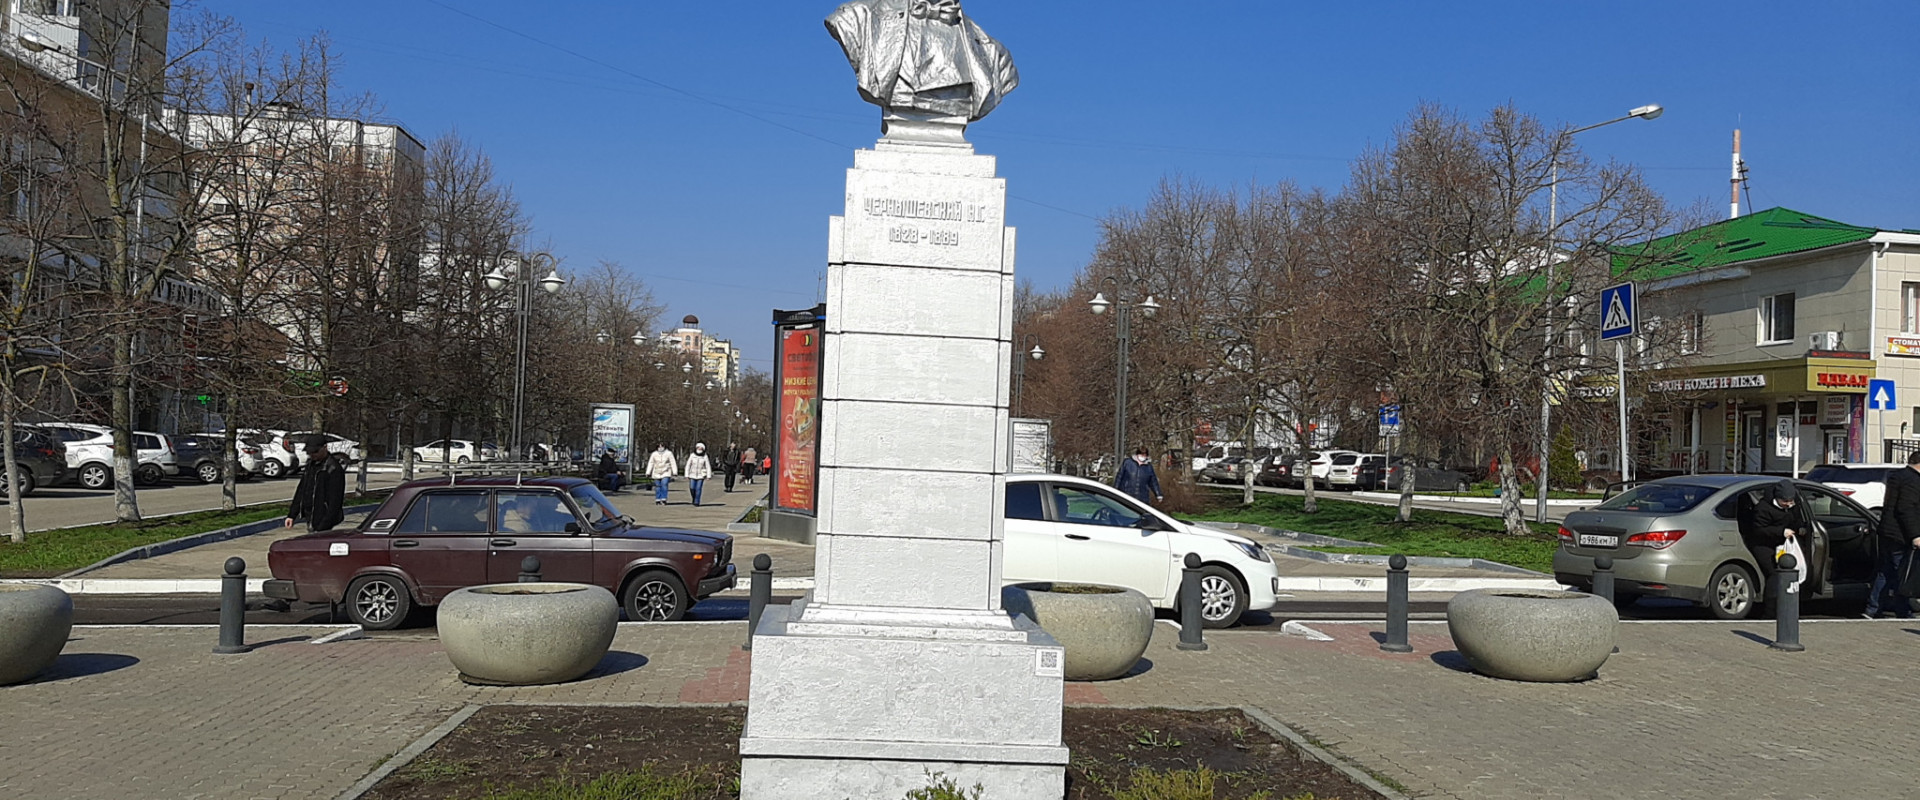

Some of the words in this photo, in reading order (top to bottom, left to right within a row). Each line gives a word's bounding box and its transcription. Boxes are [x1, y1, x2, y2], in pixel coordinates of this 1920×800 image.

[863, 197, 962, 222] ЧЕРНЫШЕВСКИЙ
[1684, 378, 1718, 391] КОЖИ
[1720, 378, 1729, 389] И
[1730, 375, 1766, 389] МЕХА
[1817, 373, 1868, 388] ИДЕАЛ
[1670, 451, 1709, 470] МЕА!
